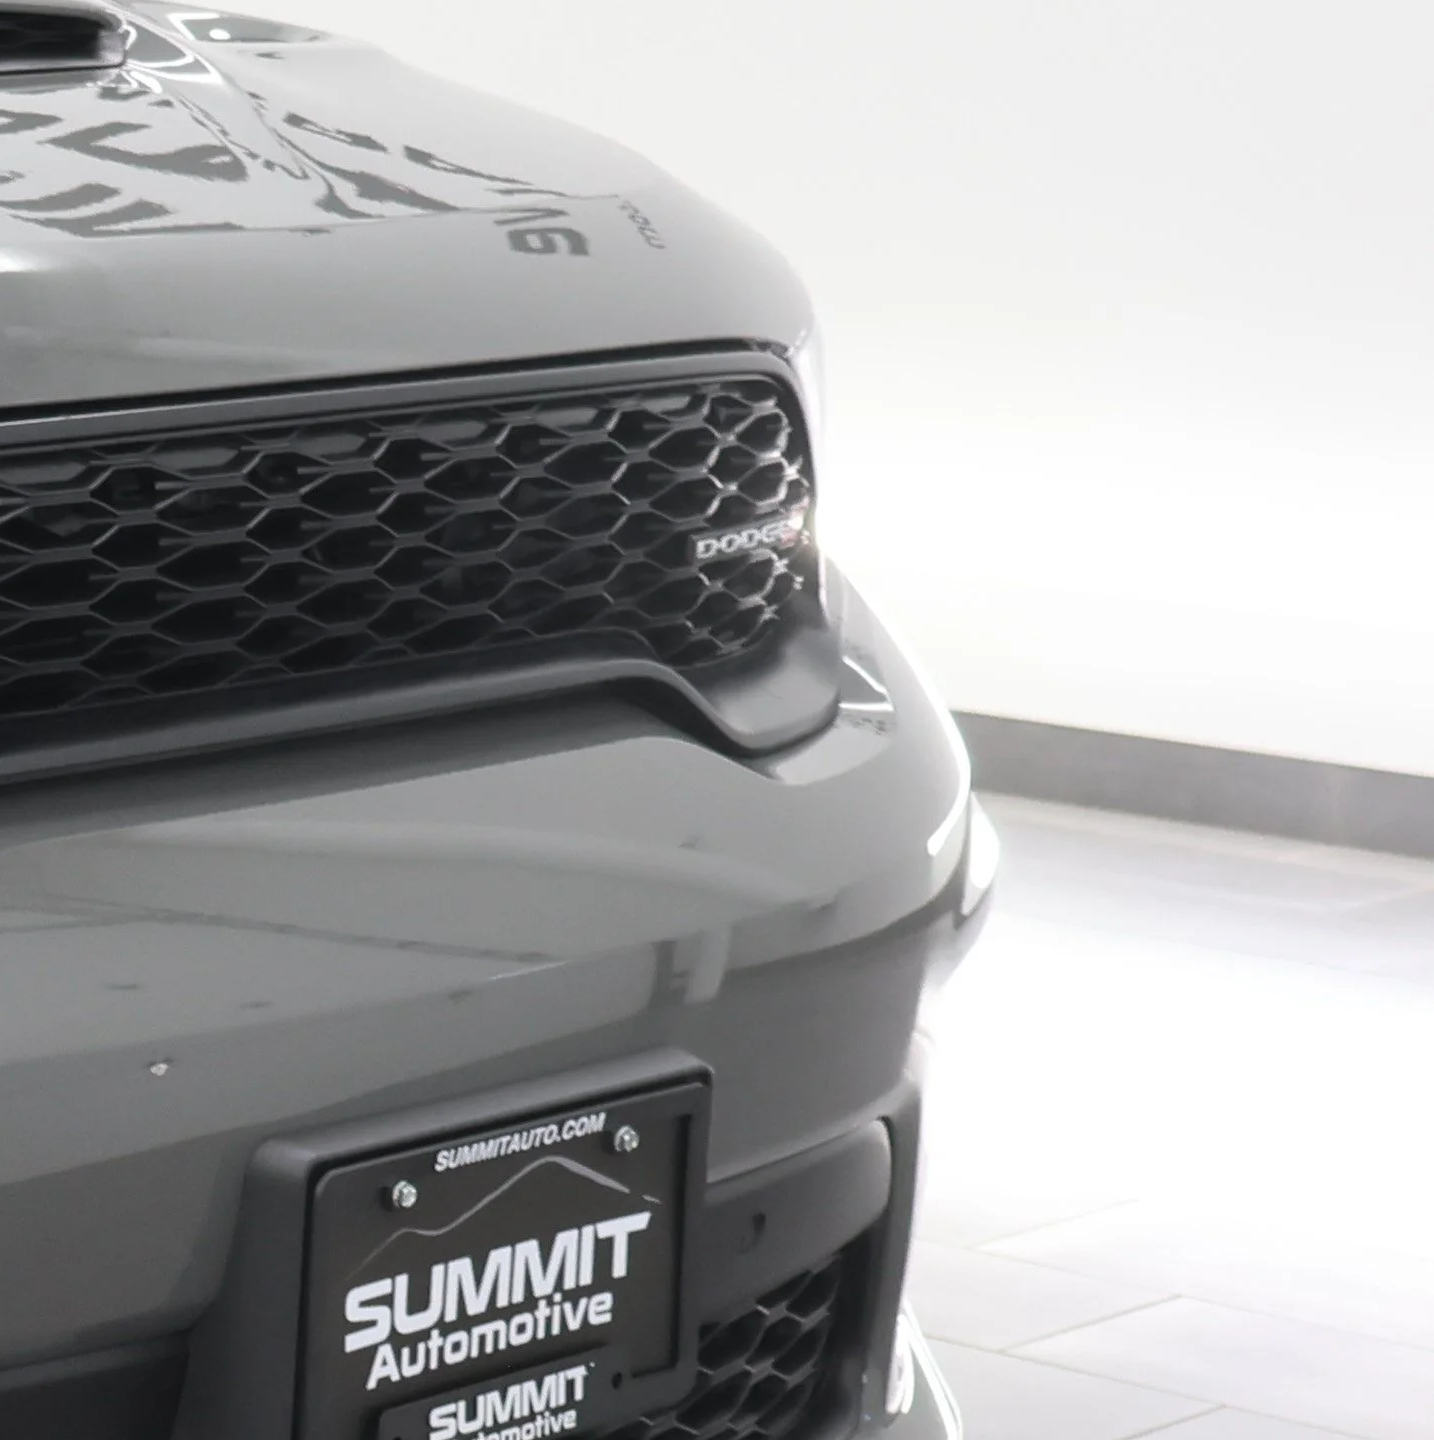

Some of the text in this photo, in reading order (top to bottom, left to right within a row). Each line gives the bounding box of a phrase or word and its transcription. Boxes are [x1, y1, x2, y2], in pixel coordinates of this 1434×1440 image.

[434, 1111, 608, 1173] SUMMITAUTO.COM
[344, 1210, 652, 1354] SUMMIT
[366, 1290, 614, 1391] Automotive
